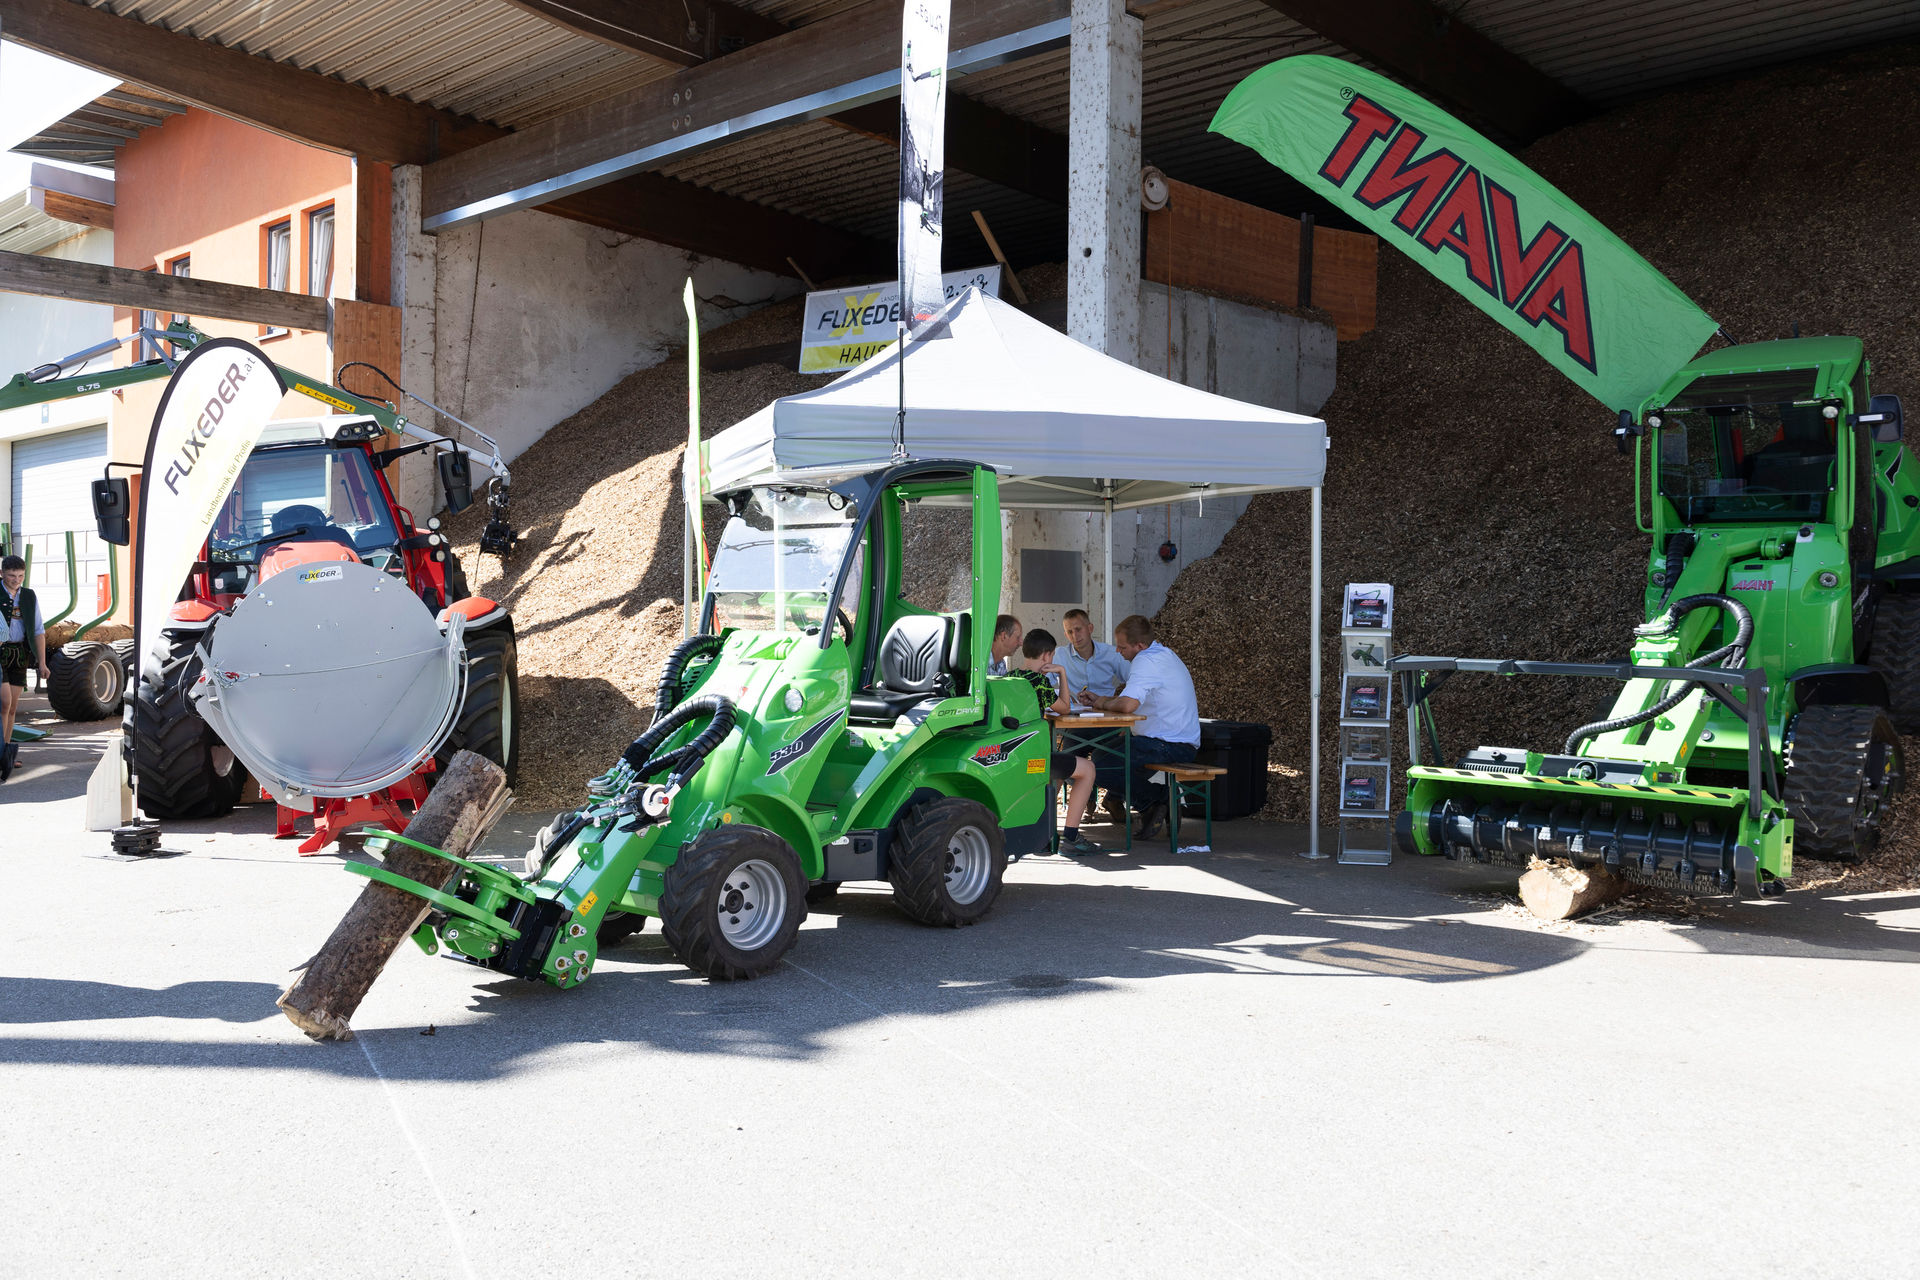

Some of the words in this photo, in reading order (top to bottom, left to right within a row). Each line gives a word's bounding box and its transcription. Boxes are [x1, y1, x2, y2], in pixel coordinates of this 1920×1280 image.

[817, 302, 899, 330] FLIXEDE
[77, 383, 101, 393] 6.75
[201, 475, 231, 525] Landtechnik
[234, 439, 251, 463] Profis
[1731, 580, 1774, 591] AVANT
[937, 707, 980, 717] OPTIDRIVE
[769, 740, 804, 762] 530
[974, 744, 1001, 758] AVANT
[986, 751, 1009, 764] 530
